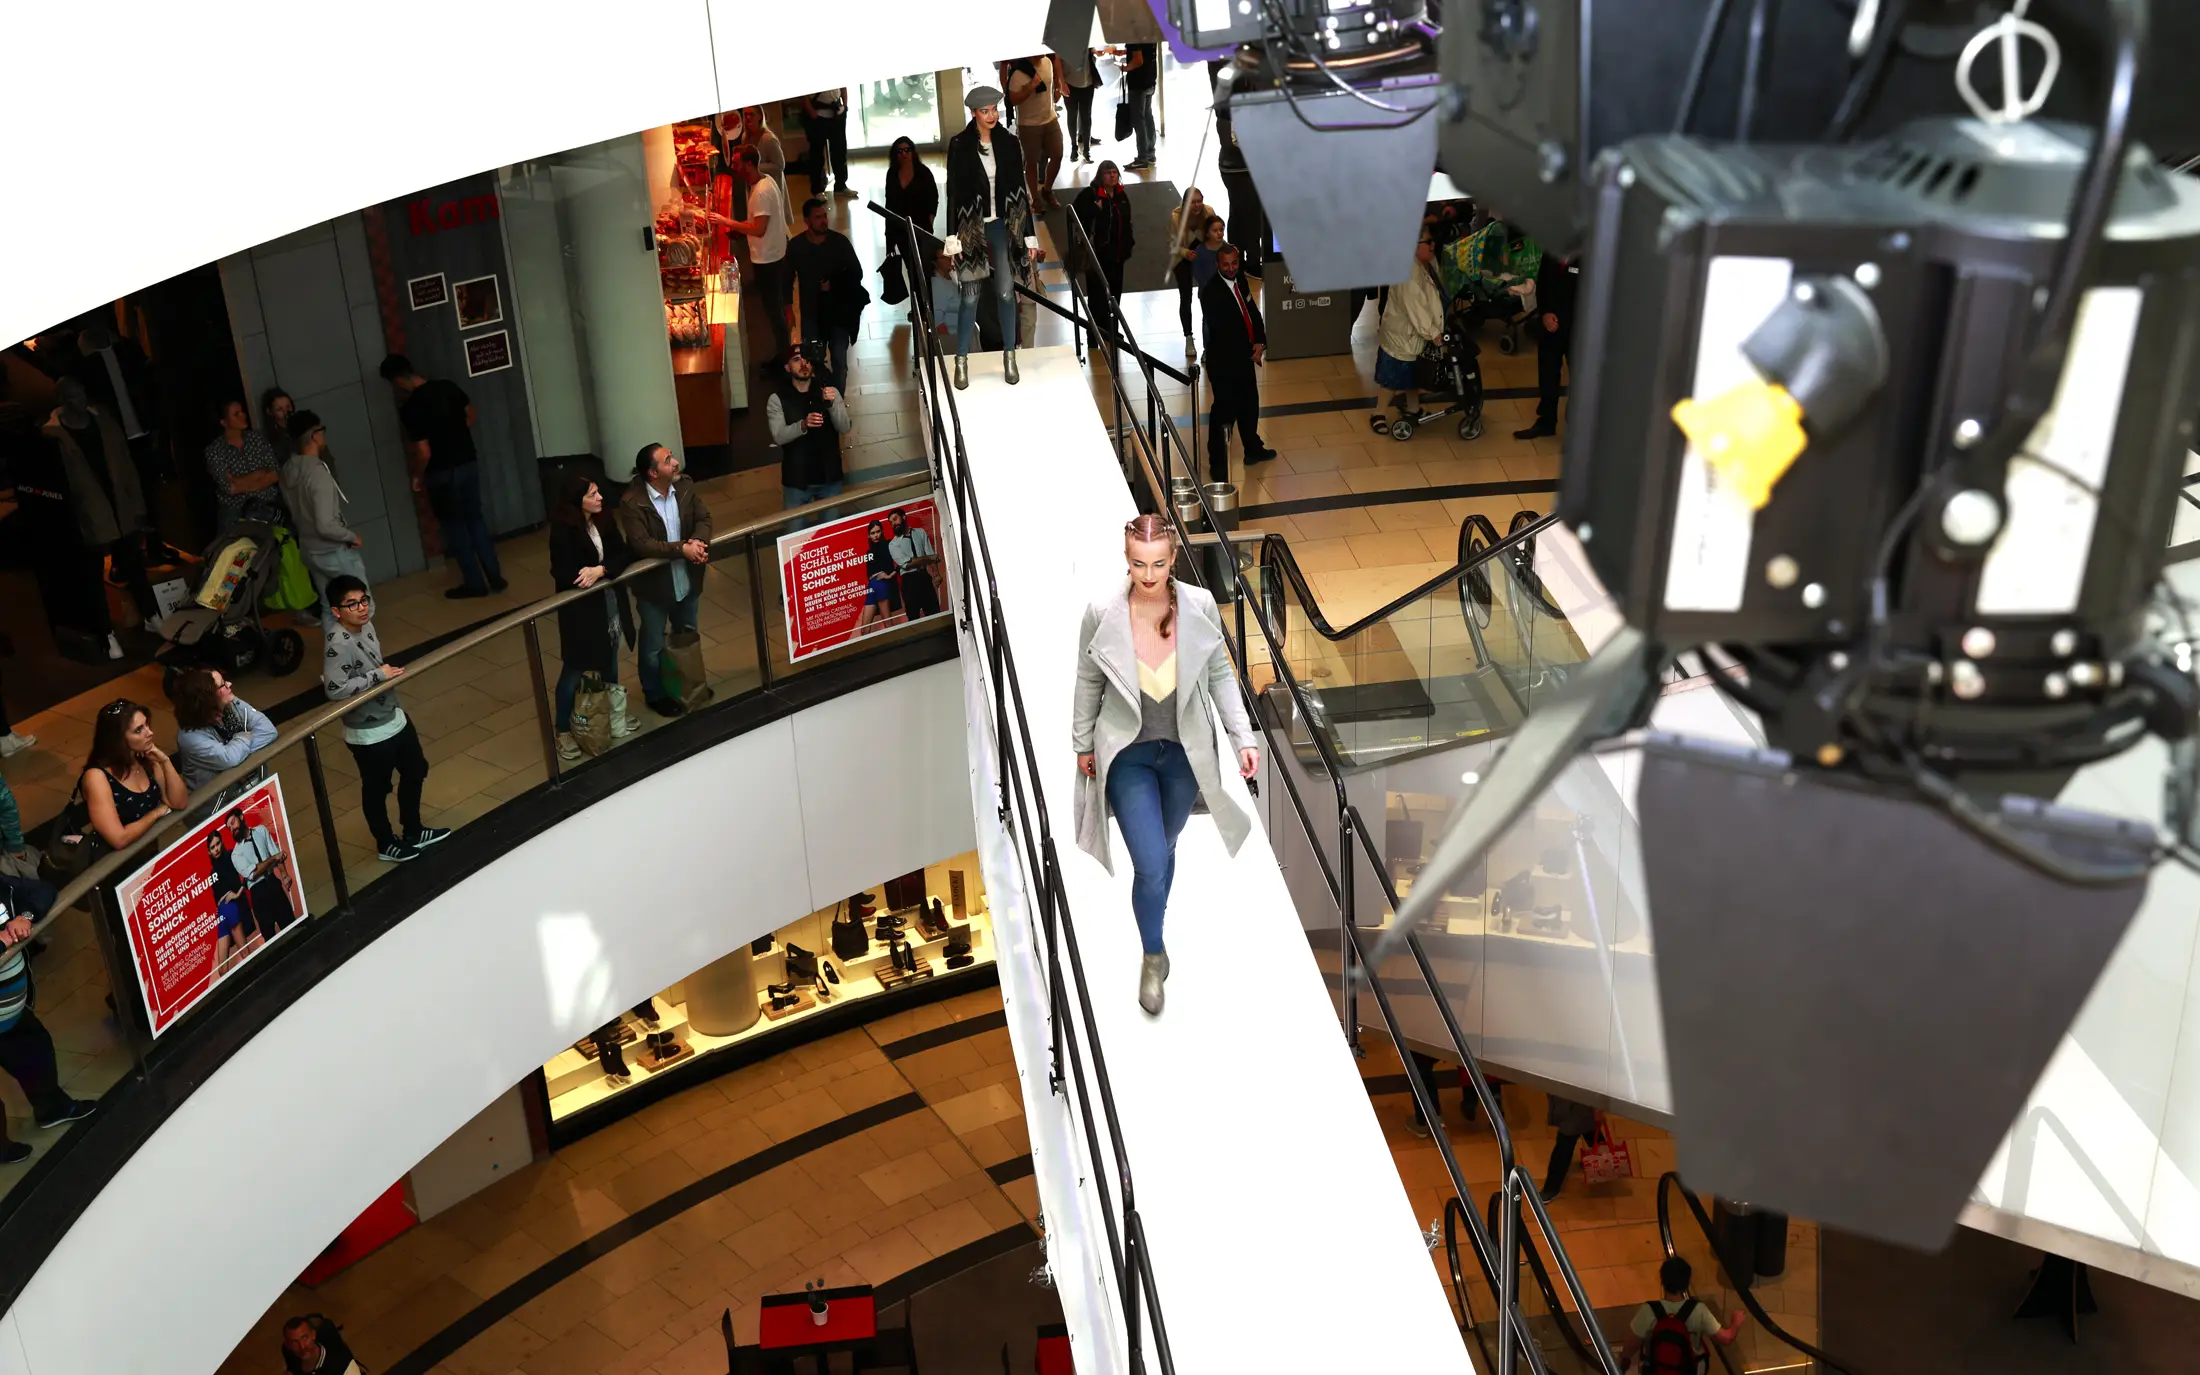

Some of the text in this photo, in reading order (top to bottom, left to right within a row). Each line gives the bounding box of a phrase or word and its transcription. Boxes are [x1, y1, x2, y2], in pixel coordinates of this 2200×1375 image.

[800, 546, 829, 562] NICHT
[801, 549, 857, 572] SCHÄL SICK.
[802, 554, 874, 582] SONDERN NEUER
[803, 574, 840, 592] SCHICK.
[805, 585, 866, 608] NEUEN KÖLN ARCADEN
[815, 585, 847, 599] ERÖFFNUNG
[848, 588, 875, 600] OKTOBER.
[142, 879, 171, 908] NICHT
[146, 873, 200, 920] SCHÄL SICK.
[149, 873, 219, 932] SONDERN NEUER
[152, 911, 188, 944] SCHICK.
[156, 912, 208, 957] DIE ERÖFFNUNG DER
[157, 914, 216, 964] NEUEN KÖLN ARCADEN
[160, 916, 226, 971] AM 13. UND 14. OKTOBER.
[163, 945, 212, 986] TOLLEN AKTIONEN UND
[165, 978, 180, 992] VIELEN
